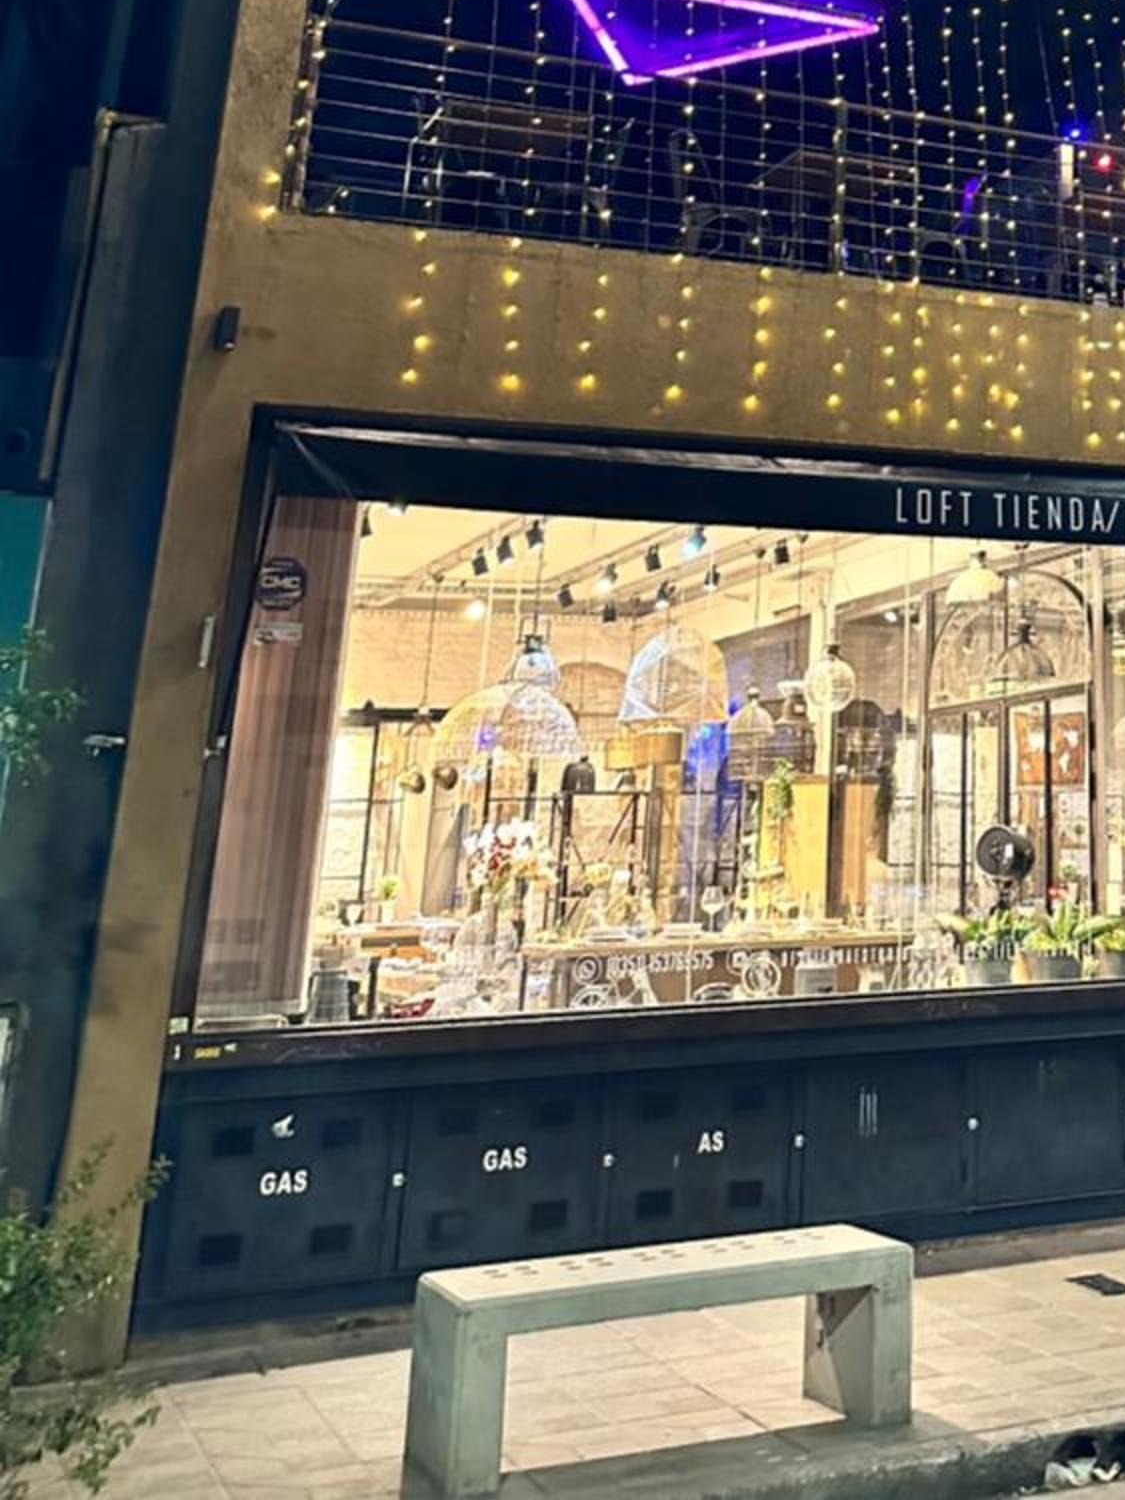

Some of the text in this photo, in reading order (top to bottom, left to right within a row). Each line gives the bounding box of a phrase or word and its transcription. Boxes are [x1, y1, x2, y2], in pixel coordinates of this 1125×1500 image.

[895, 487, 974, 527] LOFT
[482, 1146, 528, 1172] GAS
[259, 1169, 309, 1196] GAS
